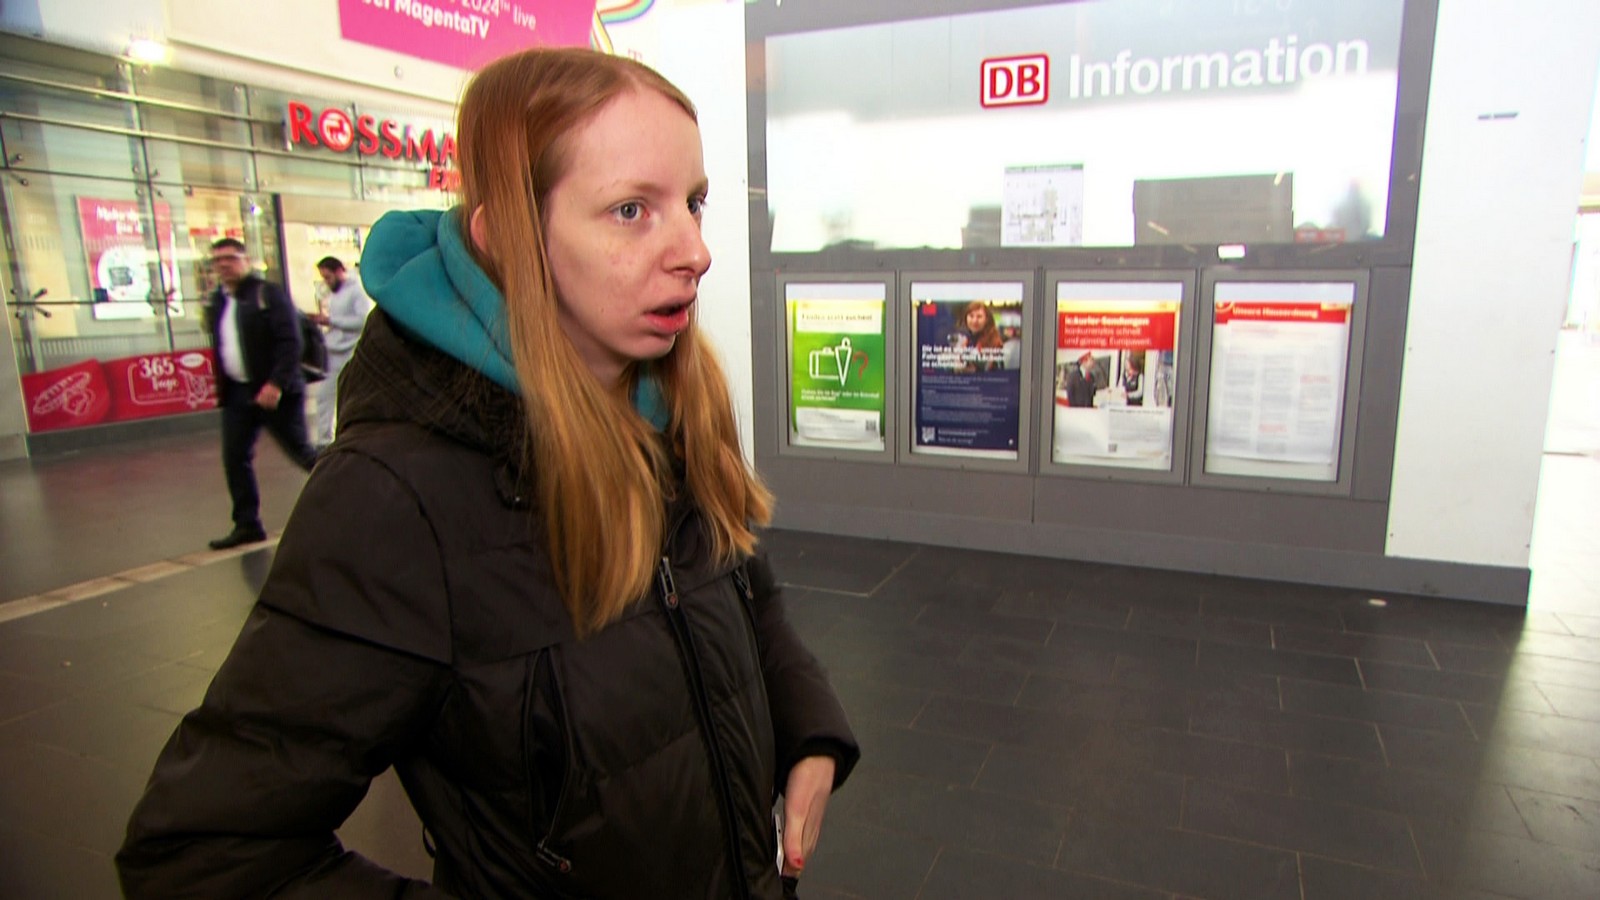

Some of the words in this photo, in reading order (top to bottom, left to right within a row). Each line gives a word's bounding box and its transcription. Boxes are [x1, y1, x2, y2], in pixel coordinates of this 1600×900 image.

[394, 0, 490, 39] MagentaTV
[513, 4, 537, 31] live
[988, 63, 1042, 100] DB
[1068, 34, 1370, 99] Information
[138, 357, 176, 379] 365
